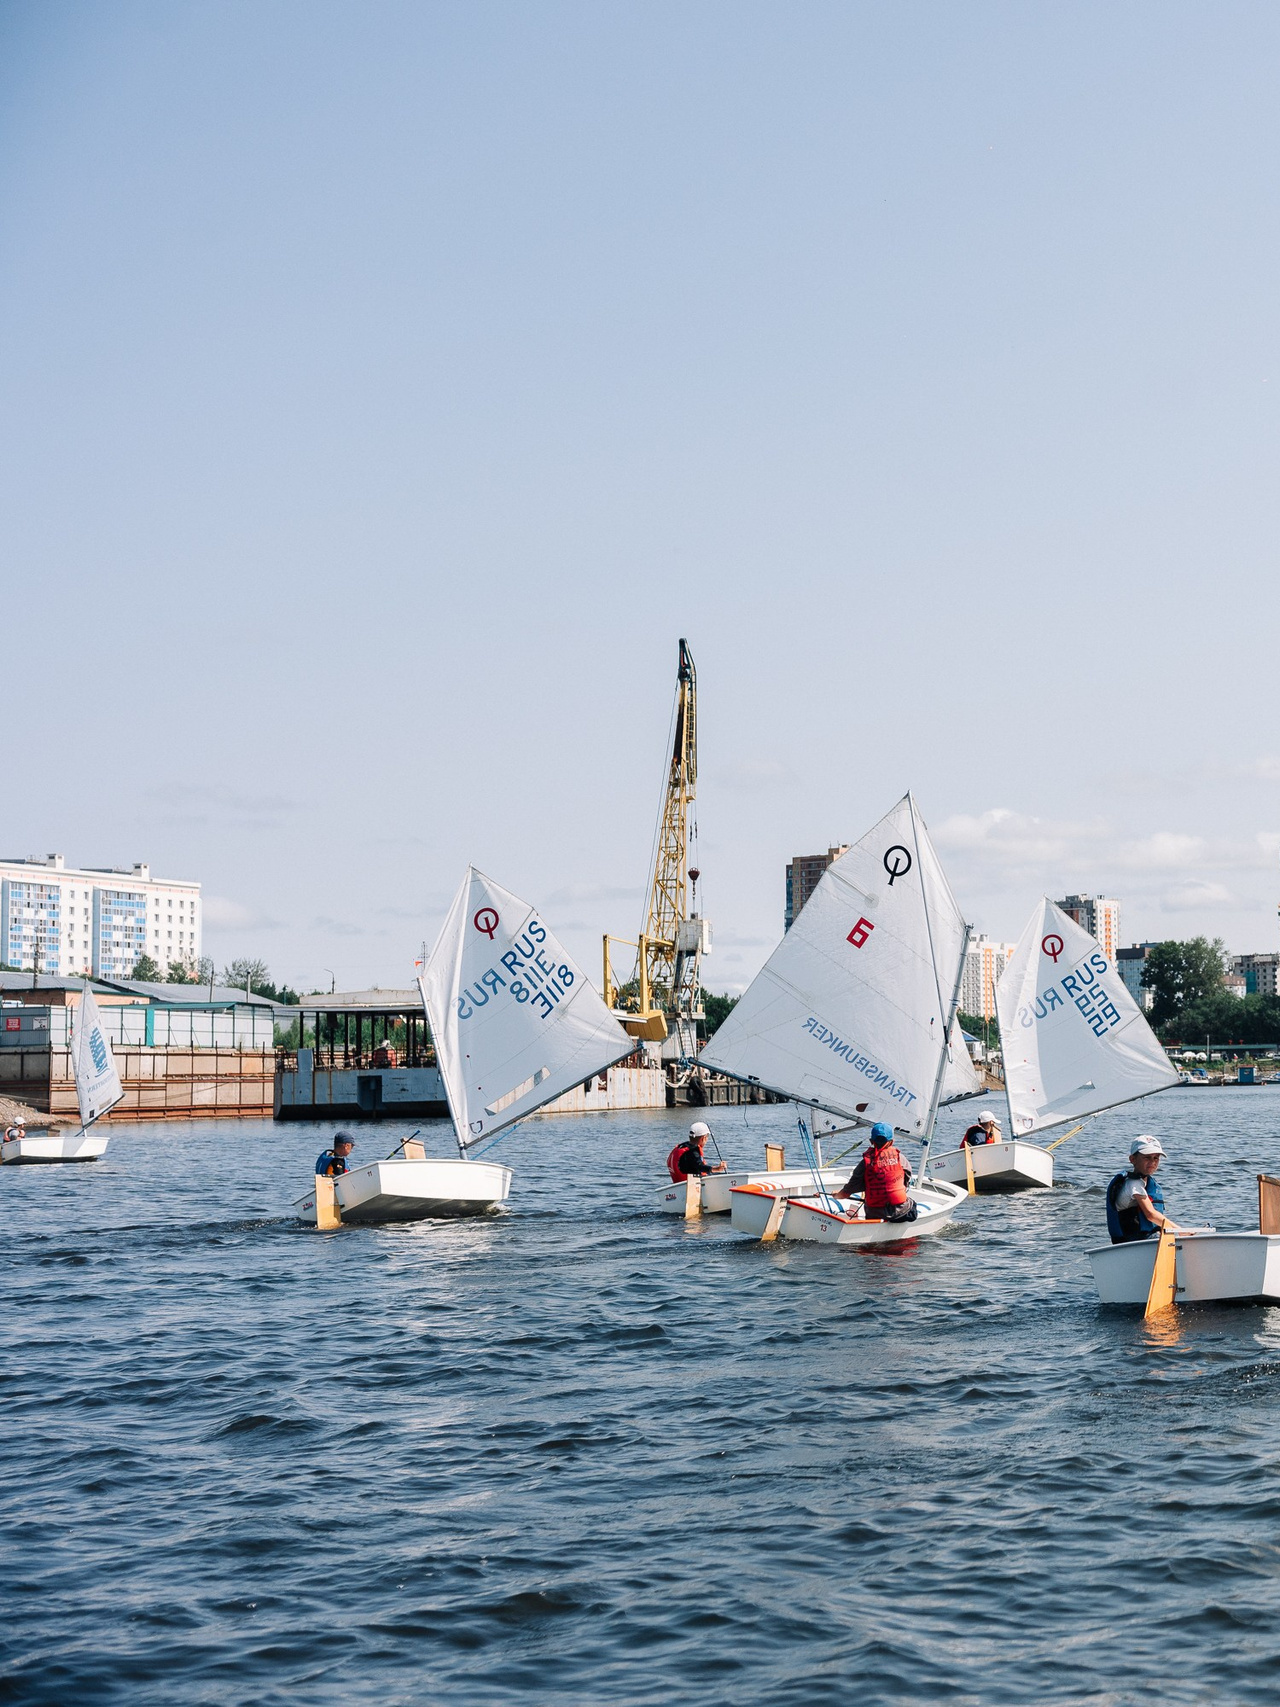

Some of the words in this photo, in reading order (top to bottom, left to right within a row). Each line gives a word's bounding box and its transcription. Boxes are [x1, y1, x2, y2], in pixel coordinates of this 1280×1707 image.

[500, 920, 547, 976] RUS
[846, 917, 875, 949] 6
[1061, 953, 1108, 998] RUS
[1087, 1002, 1122, 1038] 29
[820, 1224, 828, 1232] 13
